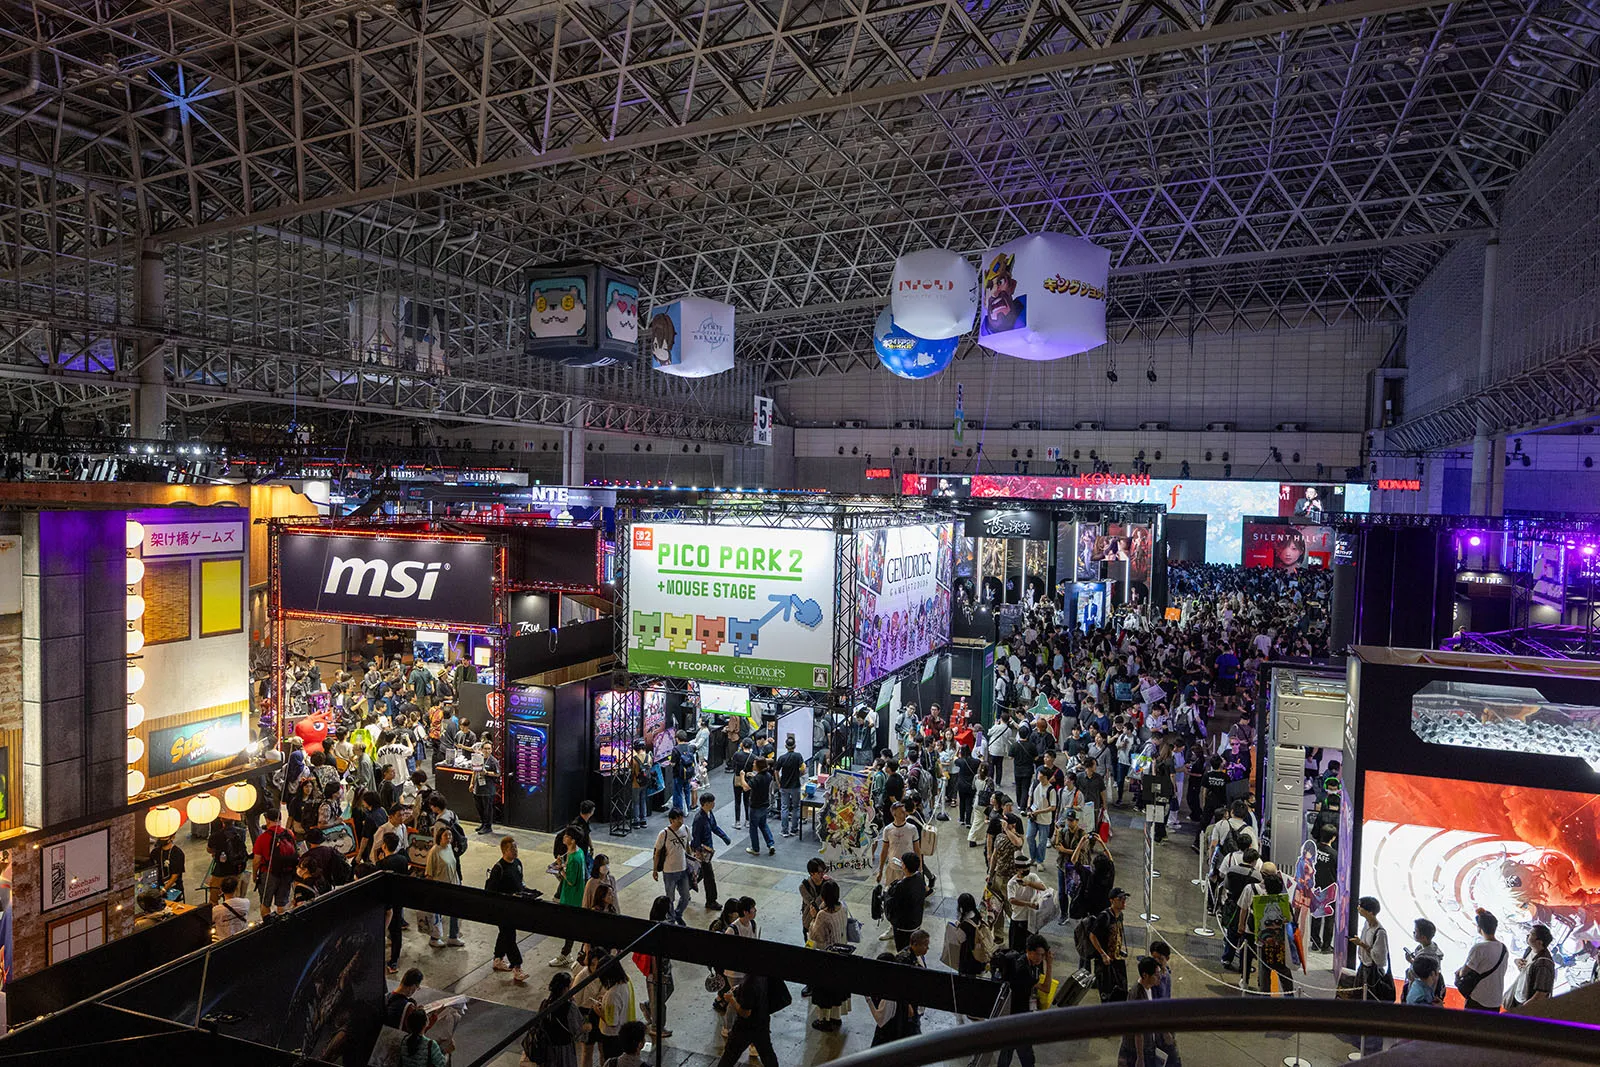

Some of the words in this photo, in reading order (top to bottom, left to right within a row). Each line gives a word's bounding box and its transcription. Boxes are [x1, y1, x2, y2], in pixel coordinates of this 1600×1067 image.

[759, 400, 767, 430] 5
[464, 471, 501, 481] CRIMSON
[1079, 472, 1151, 486] KONAMI
[1378, 480, 1420, 491] KONAMI
[532, 487, 568, 503] NTE
[1055, 486, 1119, 500] SILENT
[1124, 489, 1162, 501] HILL
[1169, 484, 1183, 510] f
[983, 511, 1031, 535] 恋と深空
[150, 529, 235, 547] 架け橋ゲームズ
[1253, 533, 1290, 541] SILENT
[657, 543, 710, 568] PICO
[720, 546, 782, 572] PARK
[789, 549, 803, 573] 2
[886, 551, 932, 584] GEMDROPS
[713, 582, 756, 600] STAGE
[677, 661, 726, 673] TECOPARK
[733, 664, 786, 679] GEMDROPS
[453, 773, 470, 781] msi
[68, 887, 90, 899] Games
